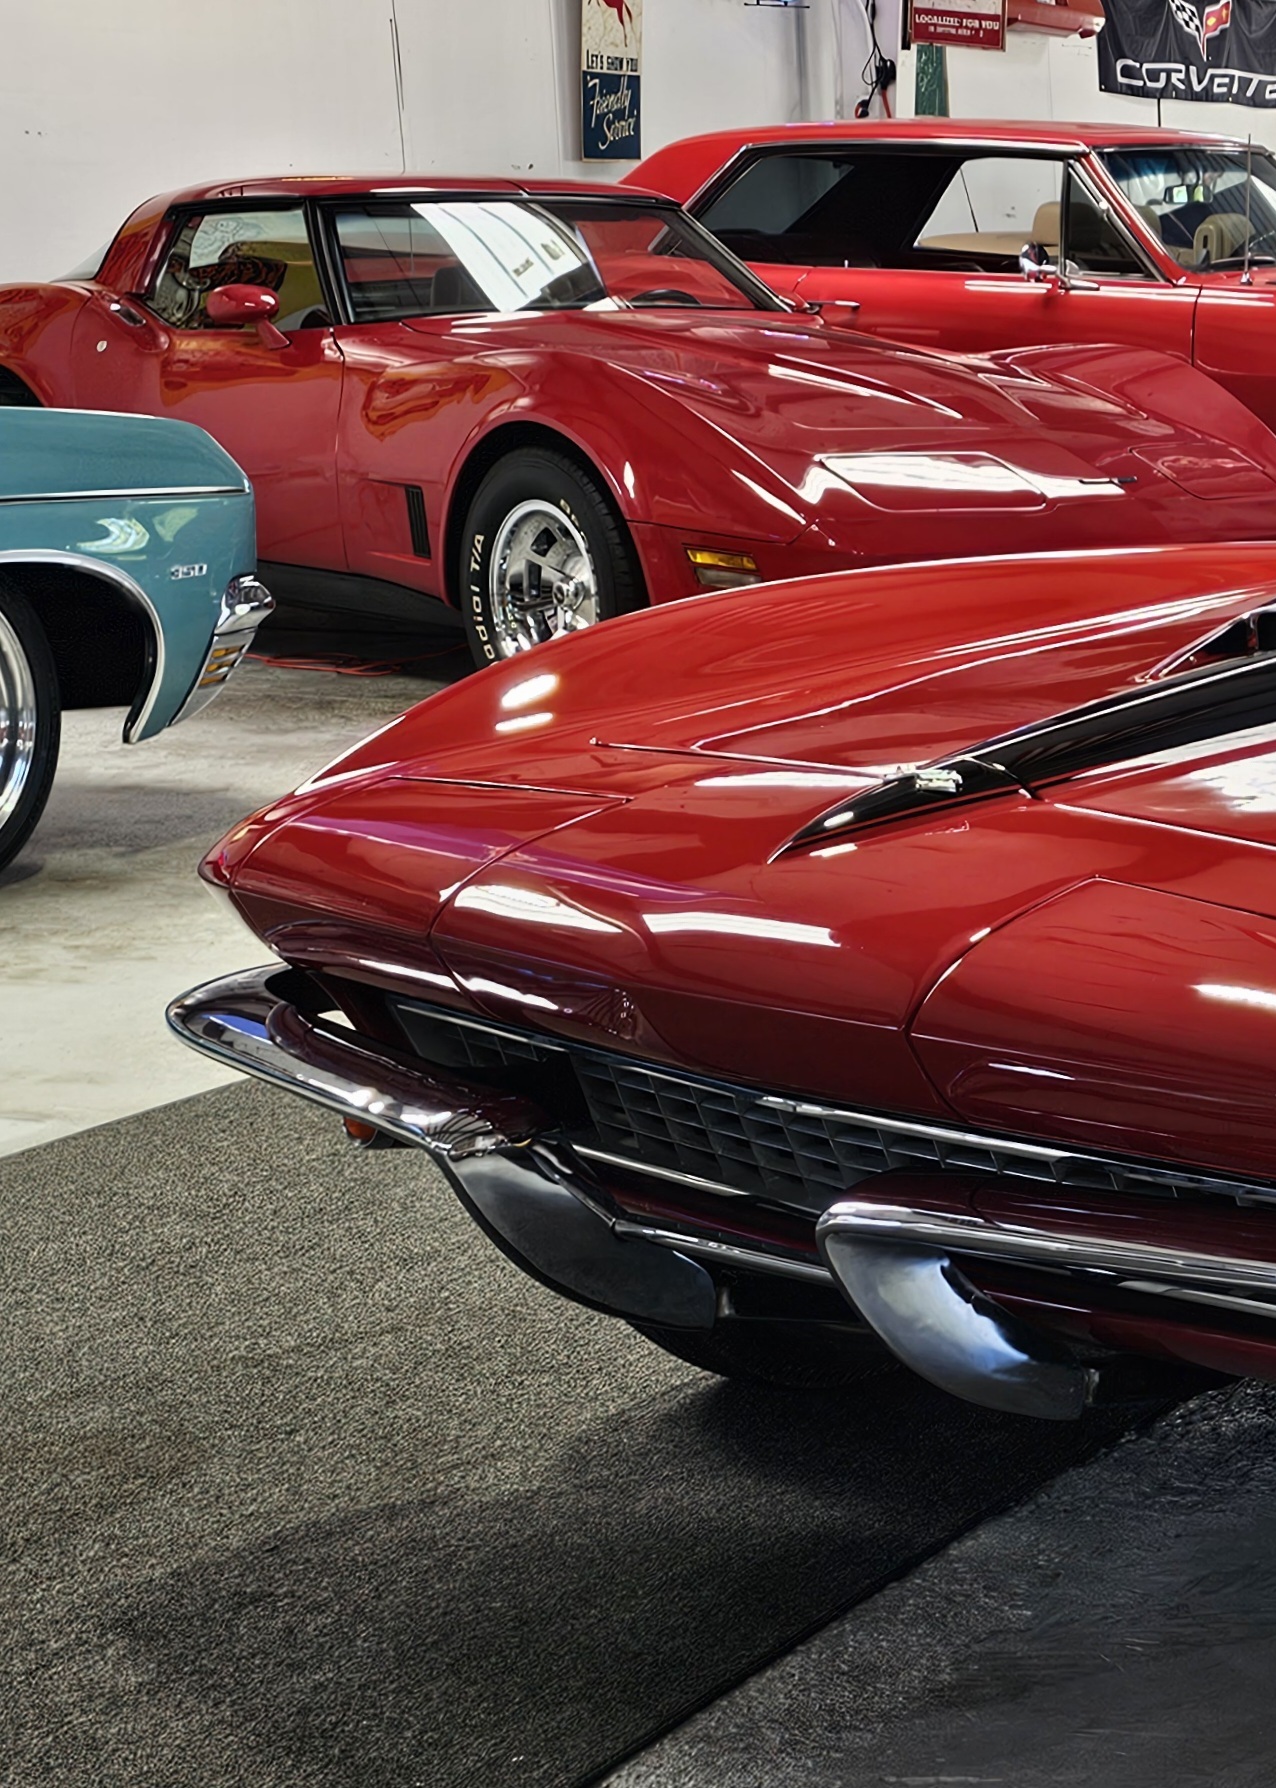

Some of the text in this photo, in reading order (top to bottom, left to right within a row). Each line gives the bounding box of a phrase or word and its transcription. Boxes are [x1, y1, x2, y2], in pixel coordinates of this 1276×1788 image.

[981, 20, 1000, 30] YOU
[470, 534, 485, 573] T/A
[170, 563, 208, 580] 350
[470, 584, 498, 665] adial
